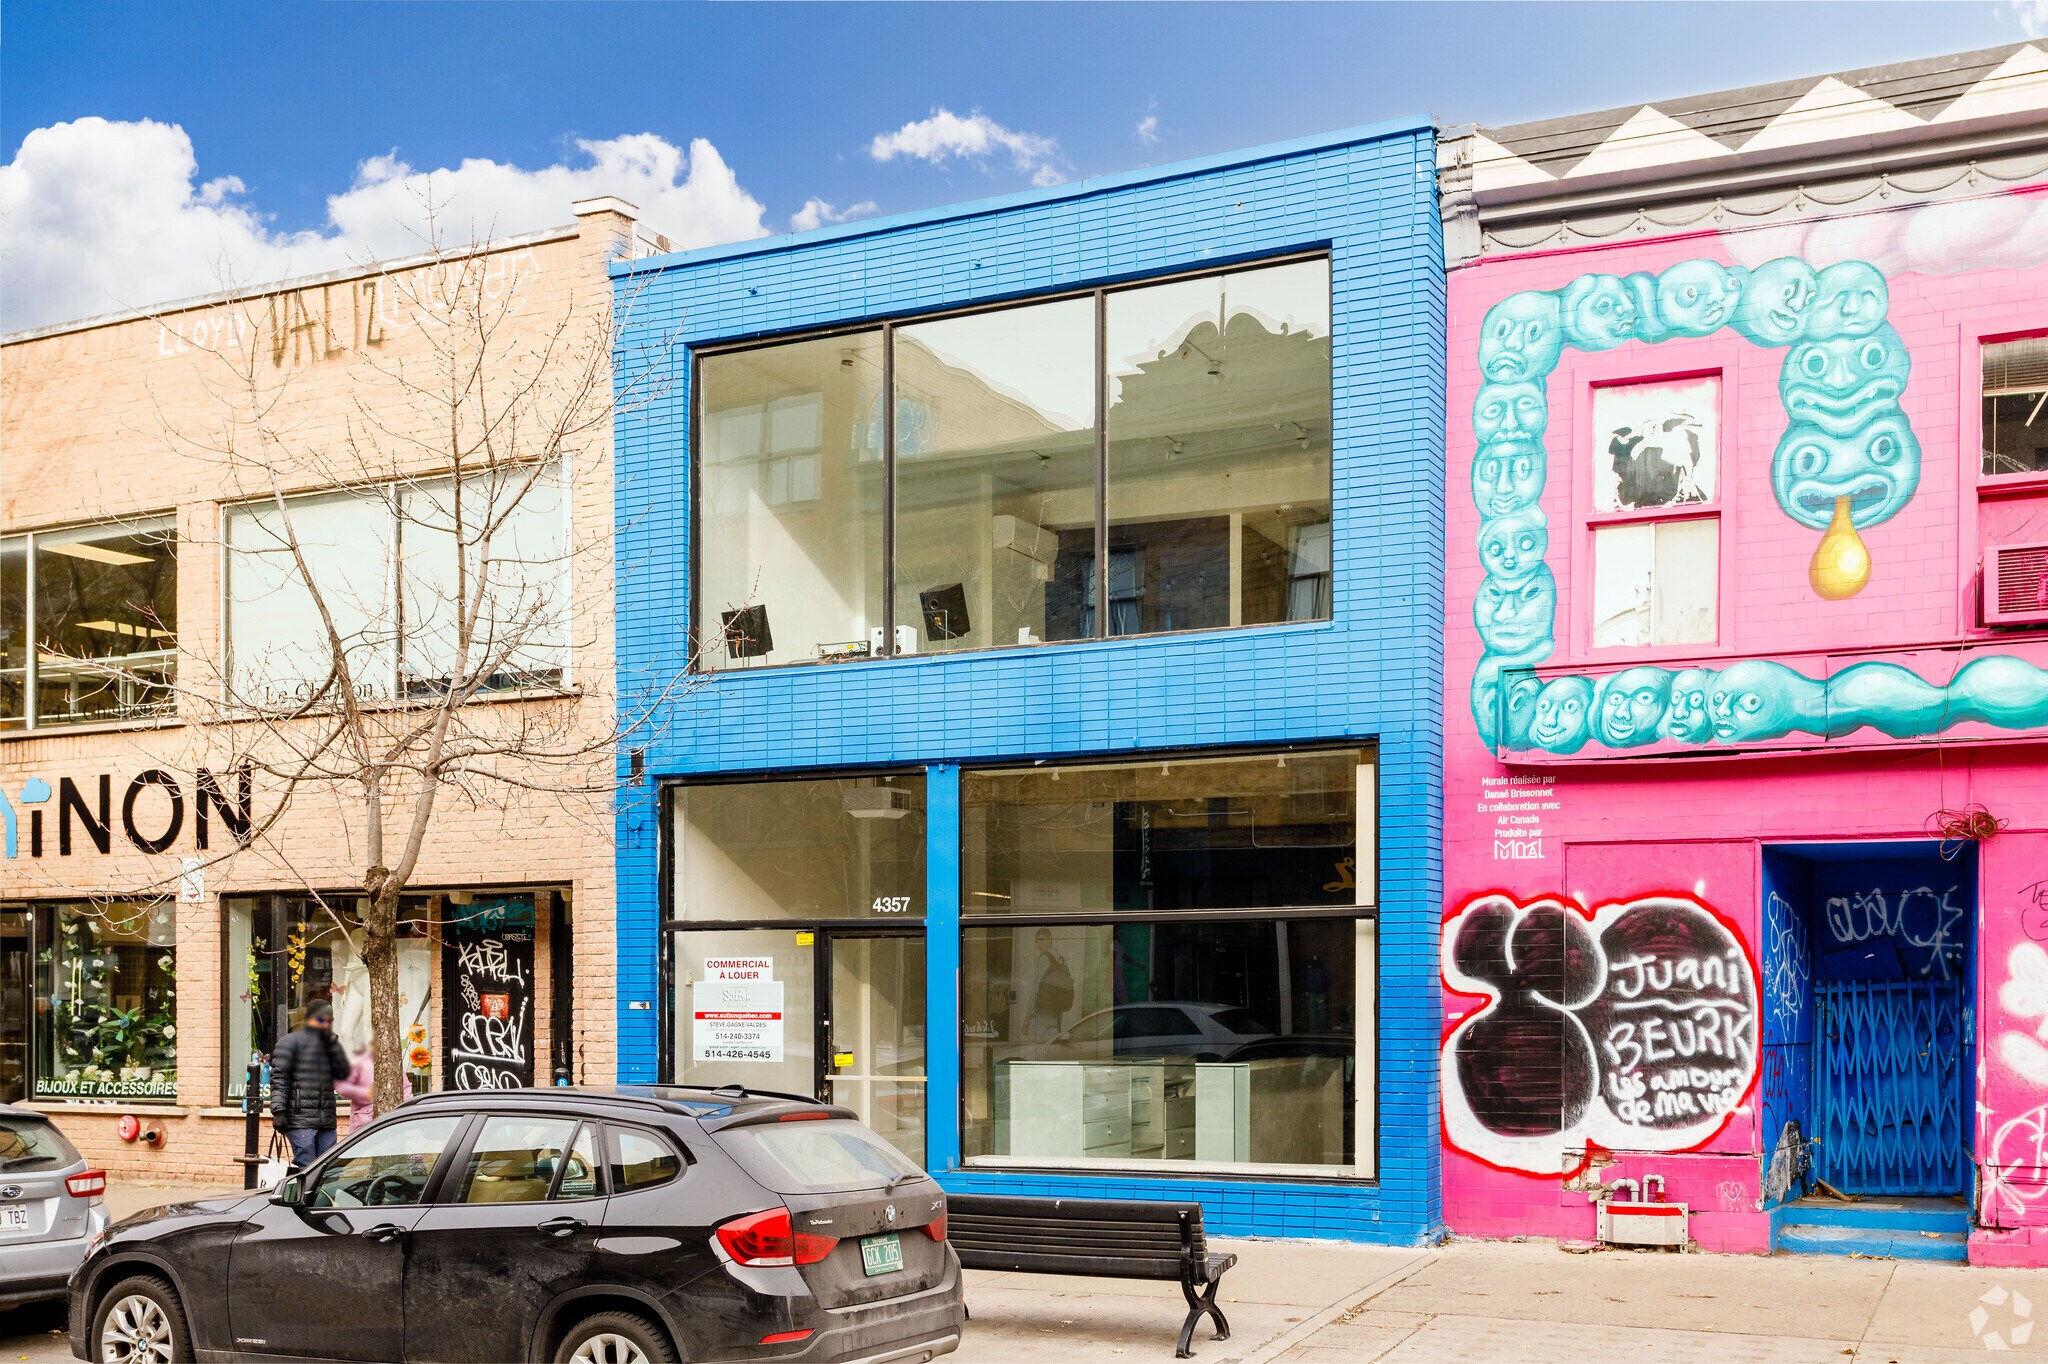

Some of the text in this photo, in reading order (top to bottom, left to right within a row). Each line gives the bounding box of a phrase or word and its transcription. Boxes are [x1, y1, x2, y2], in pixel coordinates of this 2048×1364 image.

[158, 312, 246, 356] LLOYD
[1481, 775, 1556, 786] Murale réalisée par
[1484, 788, 1553, 799] Danaé Brissonnet
[1477, 802, 1560, 812] En collaboration avec
[1497, 814, 1539, 824] Air Canada
[1494, 828, 1542, 838] Produite par
[872, 897, 910, 913] 4357
[706, 960, 769, 969] COMMERCIAL
[728, 971, 759, 980] LOUER
[1611, 948, 1740, 998] Juani
[704, 1012, 772, 1020] www.suttonquebec.com
[715, 1032, 760, 1040] 514-240-3374
[1604, 1008, 1752, 1074] BEURK
[704, 1050, 771, 1059] 514-426-4545
[36, 1080, 177, 1095] BIJOUX ET ACCESSOIRES
[228, 1083, 271, 1097] LIVES
[8, 1209, 27, 1224] TBZ
[883, 1243, 900, 1263] 205
